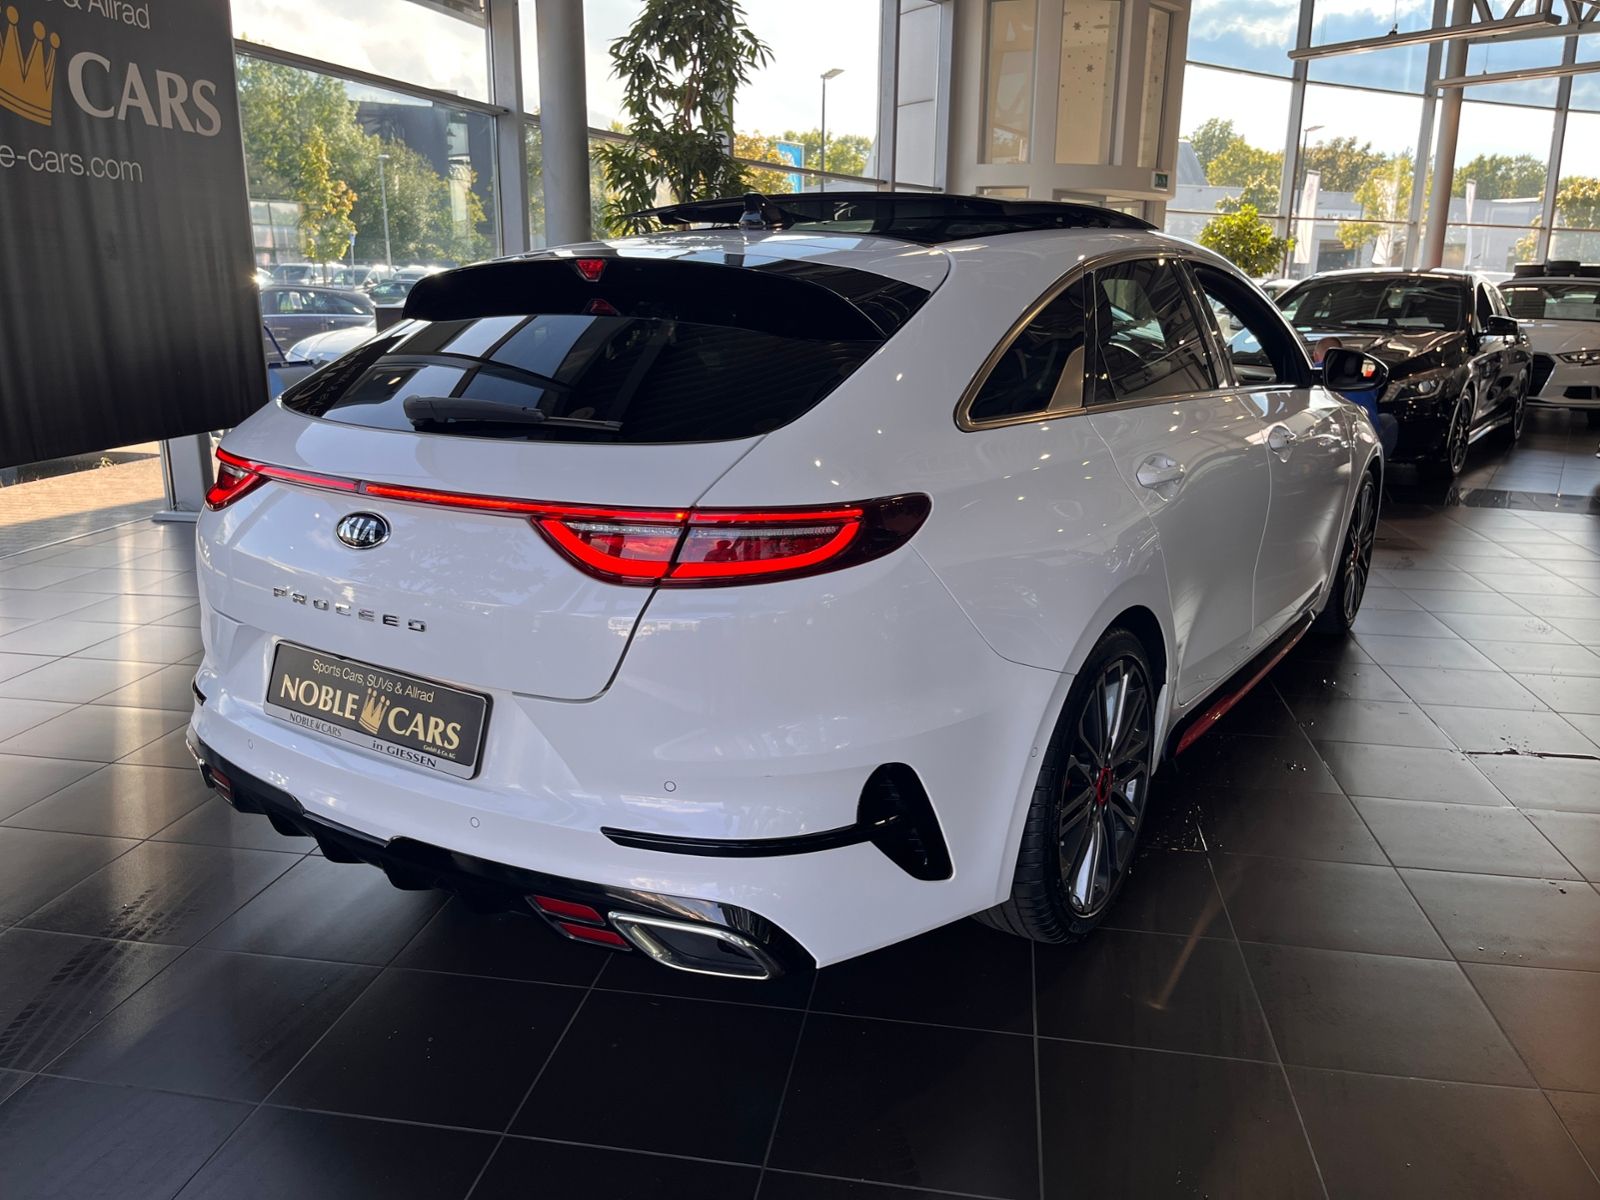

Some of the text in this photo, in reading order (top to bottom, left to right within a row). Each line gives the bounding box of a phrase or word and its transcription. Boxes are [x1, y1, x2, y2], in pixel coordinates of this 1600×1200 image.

[68, 51, 222, 137] CARS
[0, 144, 143, 182] e-cars.com
[340, 517, 377, 543] KIA
[273, 587, 427, 632] PROCEED
[312, 658, 435, 703] Sports Cars, SUVs & Allrad
[280, 673, 462, 750] NOBLE CARS
[290, 712, 343, 737] NOBLE CARS
[372, 739, 437, 768] in GIESSEN
